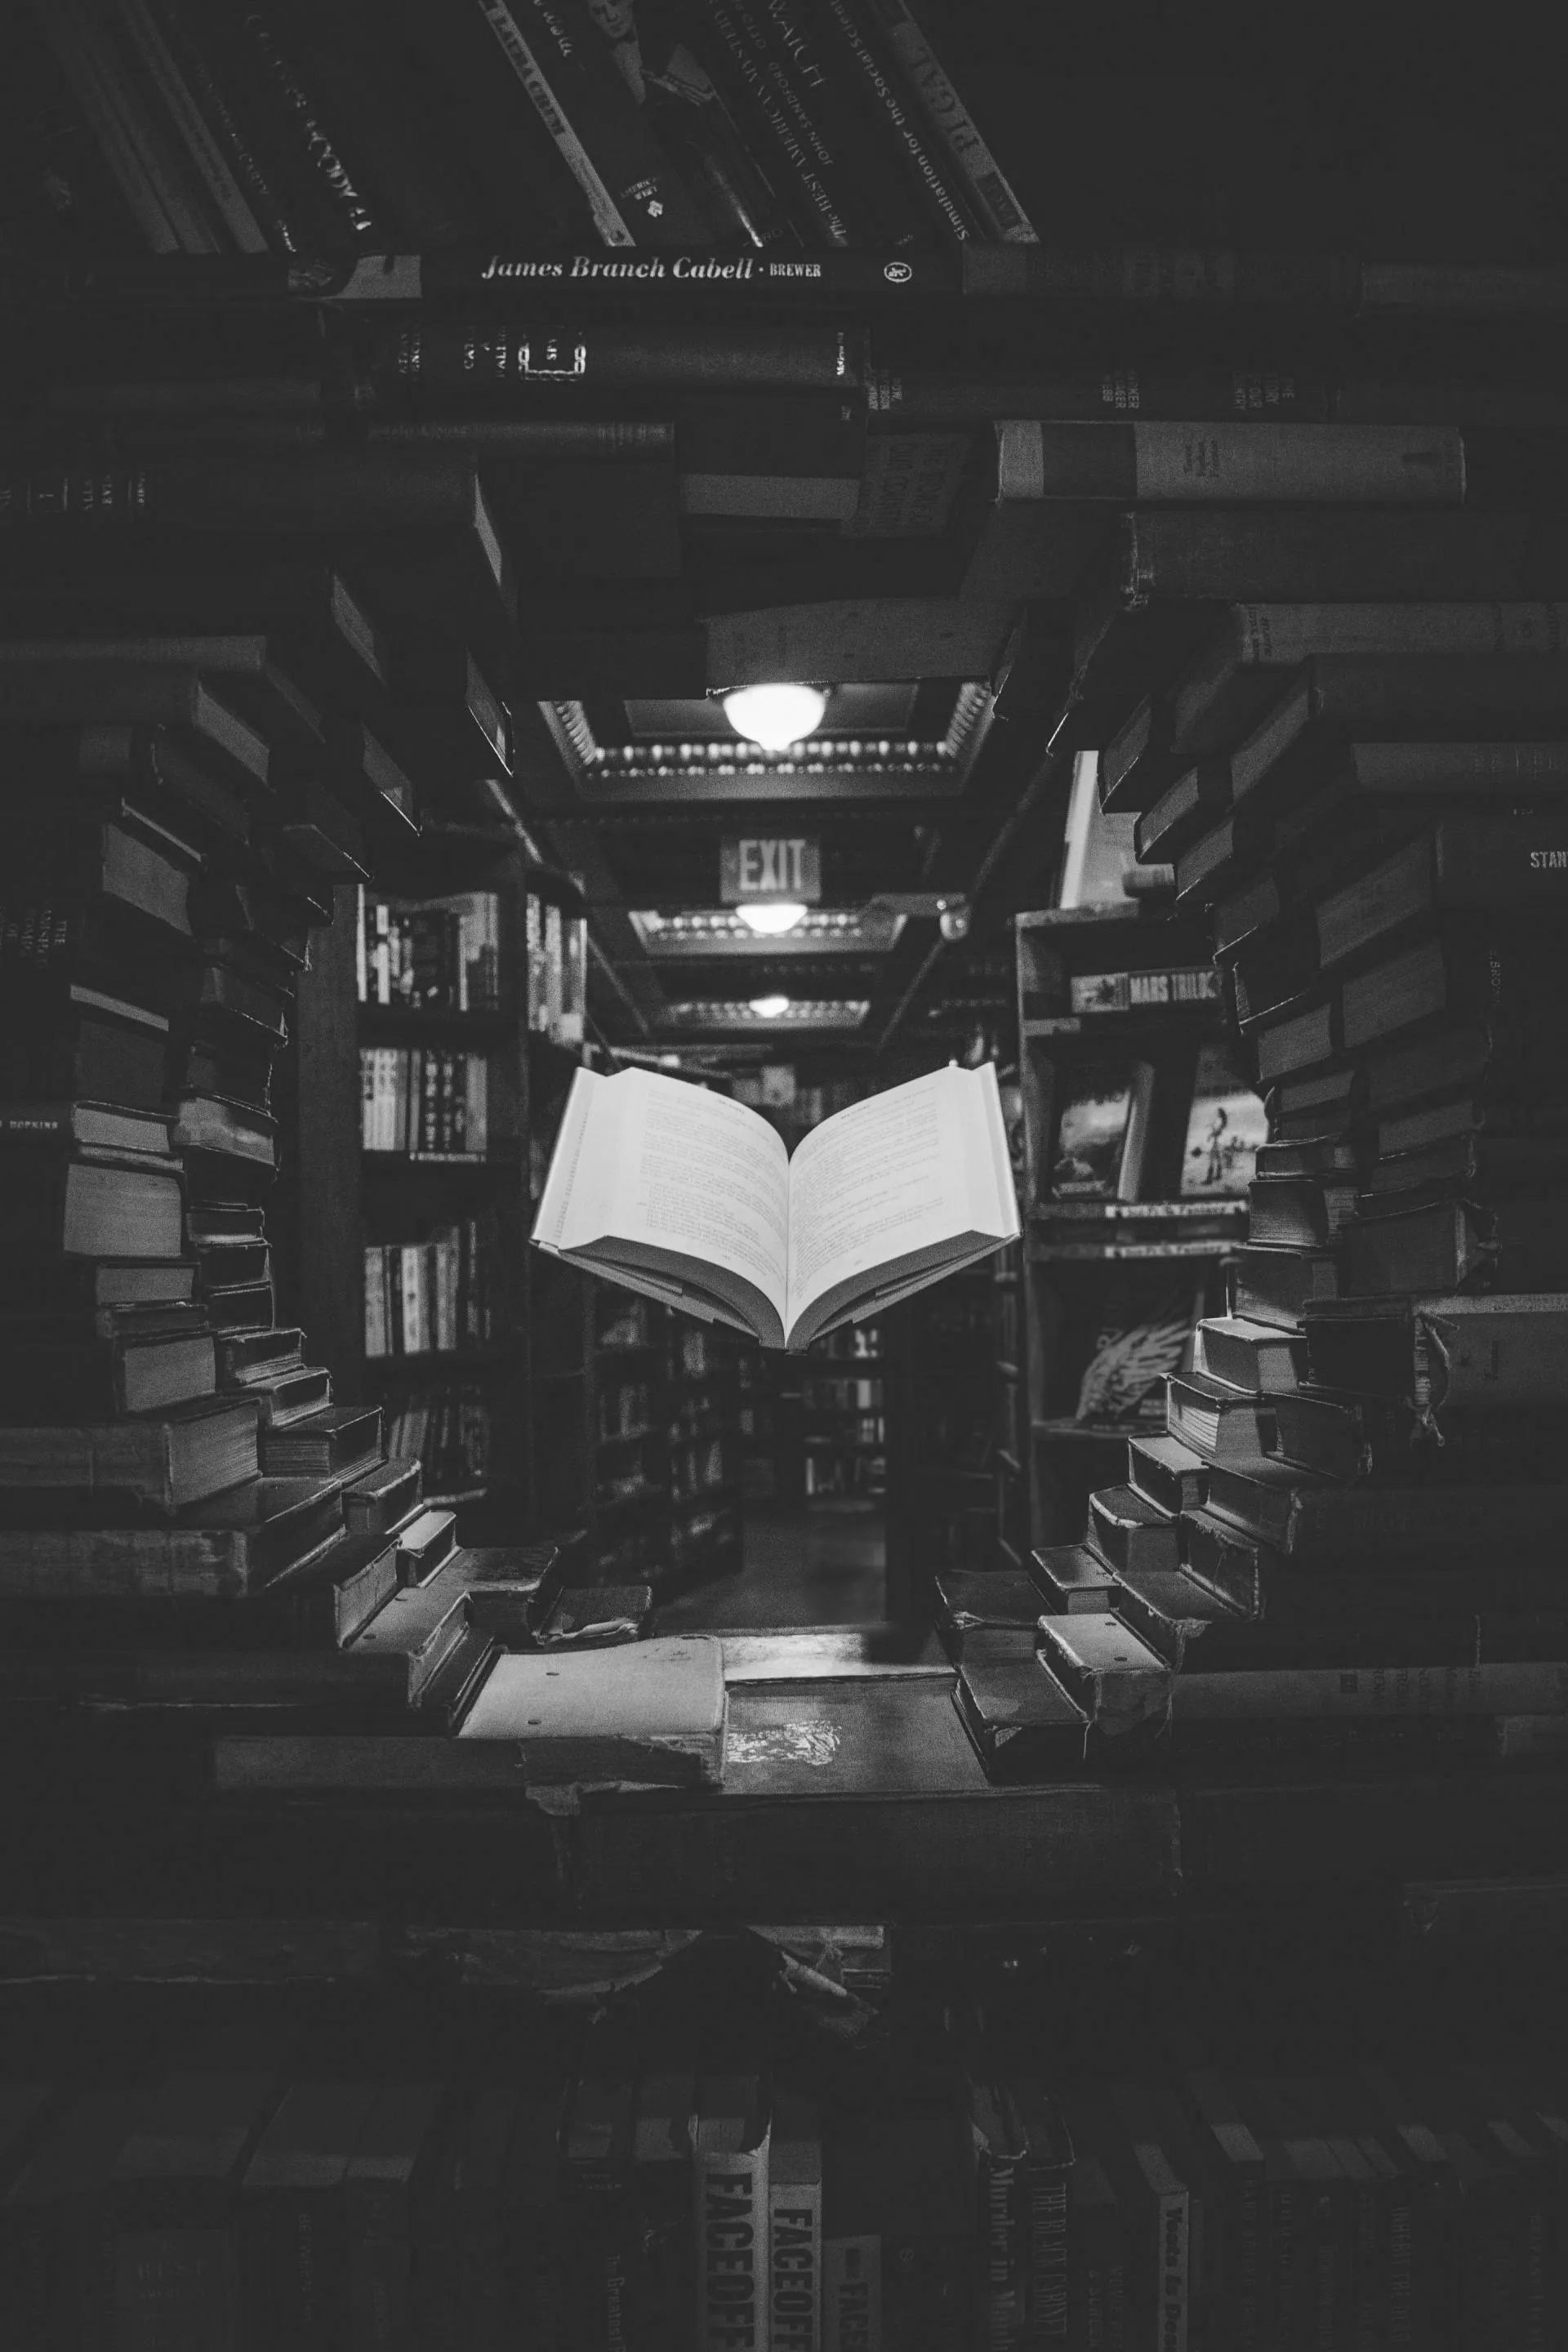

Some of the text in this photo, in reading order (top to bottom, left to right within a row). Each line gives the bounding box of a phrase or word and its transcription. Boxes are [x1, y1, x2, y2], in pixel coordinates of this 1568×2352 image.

[710, 7, 763, 83] MYSTERY
[766, 59, 813, 130] SANDFORD
[853, 47, 893, 100] Social
[751, 83, 809, 169] AMERICAN
[882, 96, 907, 127] the
[807, 129, 835, 167] JOHN
[898, 127, 923, 156] for
[800, 169, 833, 213] BEST
[912, 152, 973, 243] Simulation
[481, 256, 821, 279] James Branch Cabell BREWER
[738, 839, 807, 890] EXIT
[1530, 850, 1568, 869] STAN
[1032, 2181, 1067, 2214] THE
[706, 2172, 755, 2346] FACEOFF
[773, 2208, 813, 2352] FACEOFF
